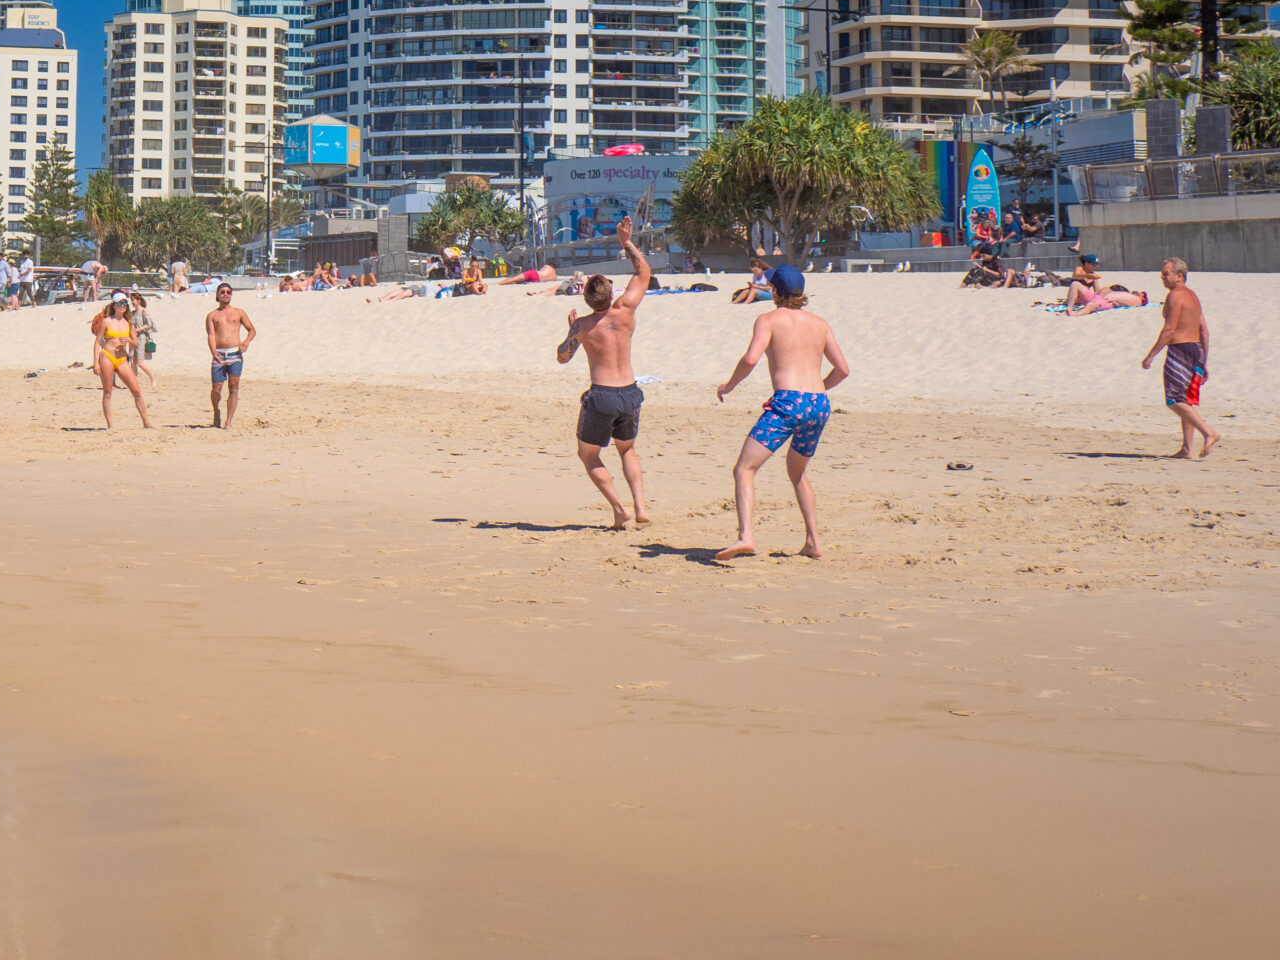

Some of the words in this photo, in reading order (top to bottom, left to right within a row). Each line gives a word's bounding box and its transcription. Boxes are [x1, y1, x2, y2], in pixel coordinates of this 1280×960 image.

[570, 169, 586, 180] Over
[588, 169, 601, 179] 120
[603, 165, 660, 183] specialty
[662, 168, 687, 182] sho
